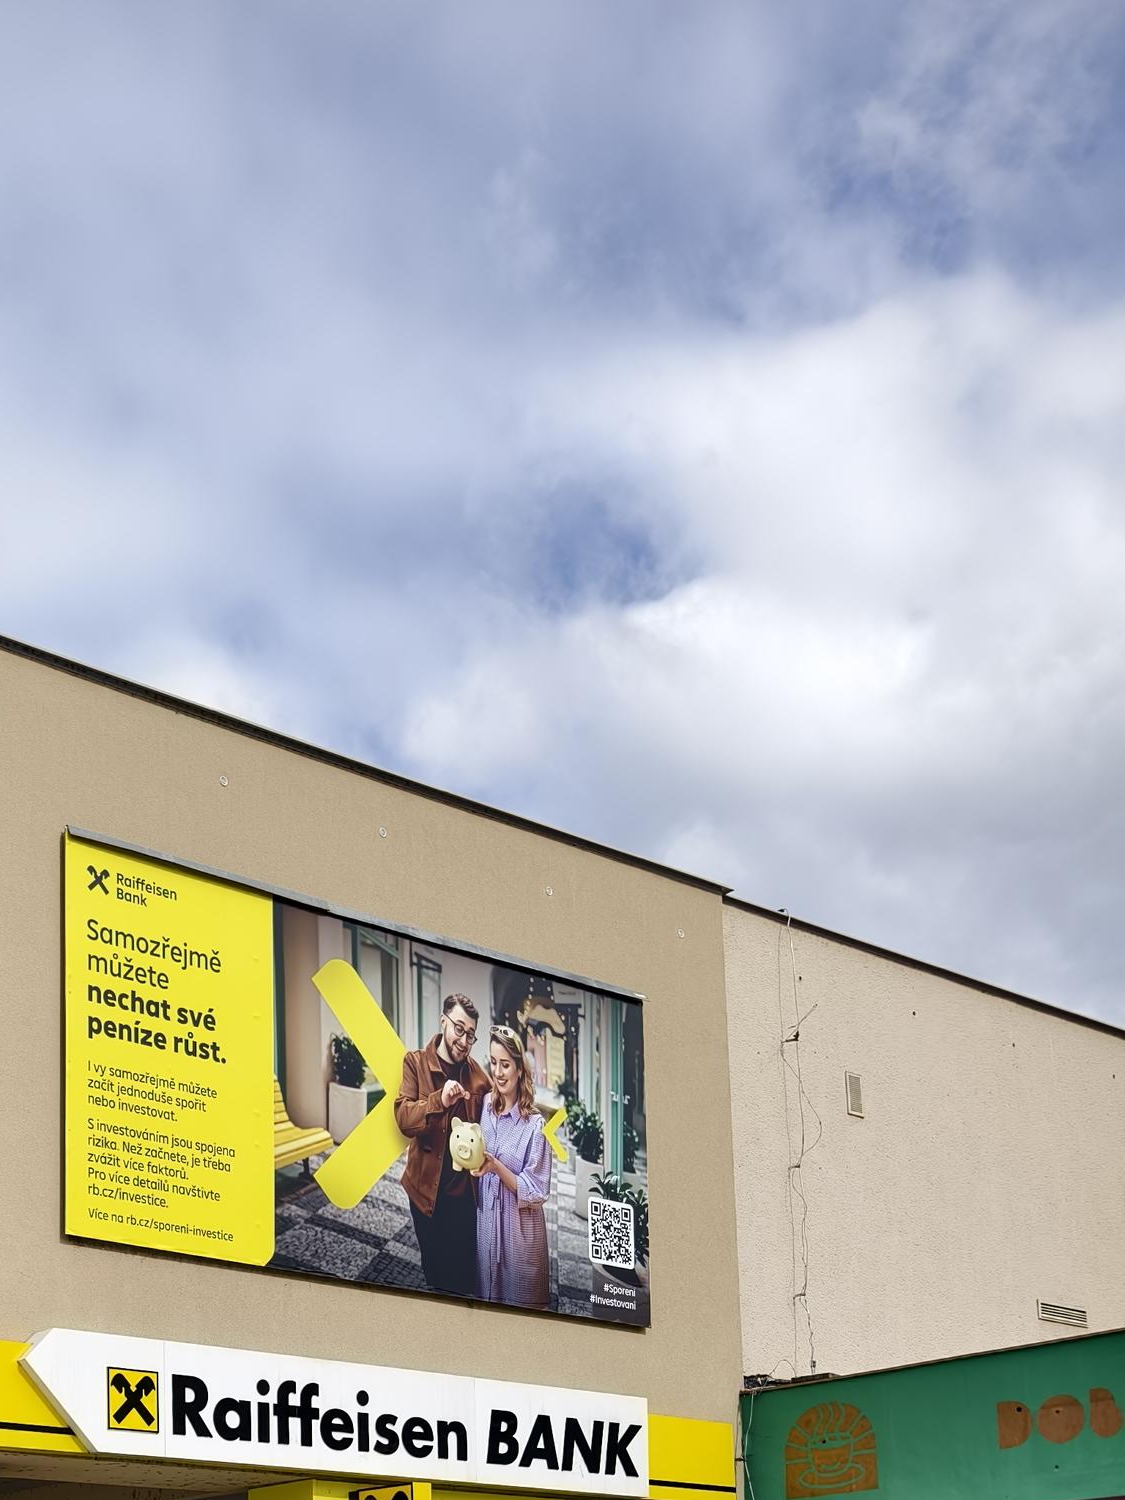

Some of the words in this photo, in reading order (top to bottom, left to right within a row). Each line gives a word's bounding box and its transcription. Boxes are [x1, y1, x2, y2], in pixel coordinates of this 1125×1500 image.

[116, 872, 177, 901] Raiffeisen
[116, 887, 148, 908] Bank
[86, 918, 221, 973] Samozřejmě
[87, 952, 169, 989] můžete
[87, 983, 171, 1022] nechat
[177, 1007, 216, 1031] své
[87, 1014, 167, 1050] peníze
[174, 1031, 227, 1065] růst.
[87, 1060, 91, 1072] I
[93, 1062, 106, 1077] vy
[109, 1064, 176, 1091] samozřejmě
[178, 1080, 218, 1099] můžete
[87, 1076, 115, 1095] začít
[117, 1082, 173, 1106] jednoduše
[175, 1094, 207, 1112] spořit
[87, 1093, 116, 1109] nebo
[118, 1099, 178, 1122] investovat.
[87, 1118, 94, 1130] S
[96, 1119, 169, 1145] investováním
[170, 1134, 192, 1149] jsou
[195, 1140, 236, 1158] spojena
[87, 1134, 120, 1151] rizika.
[122, 1140, 143, 1156] Než
[145, 1145, 189, 1166] začnete,
[190, 1153, 201, 1168] je
[203, 1157, 231, 1173] třeba
[87, 1151, 121, 1168] zvážit
[123, 1156, 145, 1172] více
[147, 1162, 189, 1181] faktorů.
[88, 1167, 106, 1181] Pro
[108, 1170, 131, 1186] více
[133, 1174, 169, 1193] detailů
[172, 1183, 221, 1202] navštivte
[88, 1183, 169, 1209] rb.cz/investice.
[88, 1206, 109, 1221] Více
[111, 1212, 124, 1224] na
[126, 1214, 234, 1242] rb.cz/sporeni-investice
[172, 1373, 468, 1462] Raiffeisen
[487, 1408, 643, 1478] BANK
